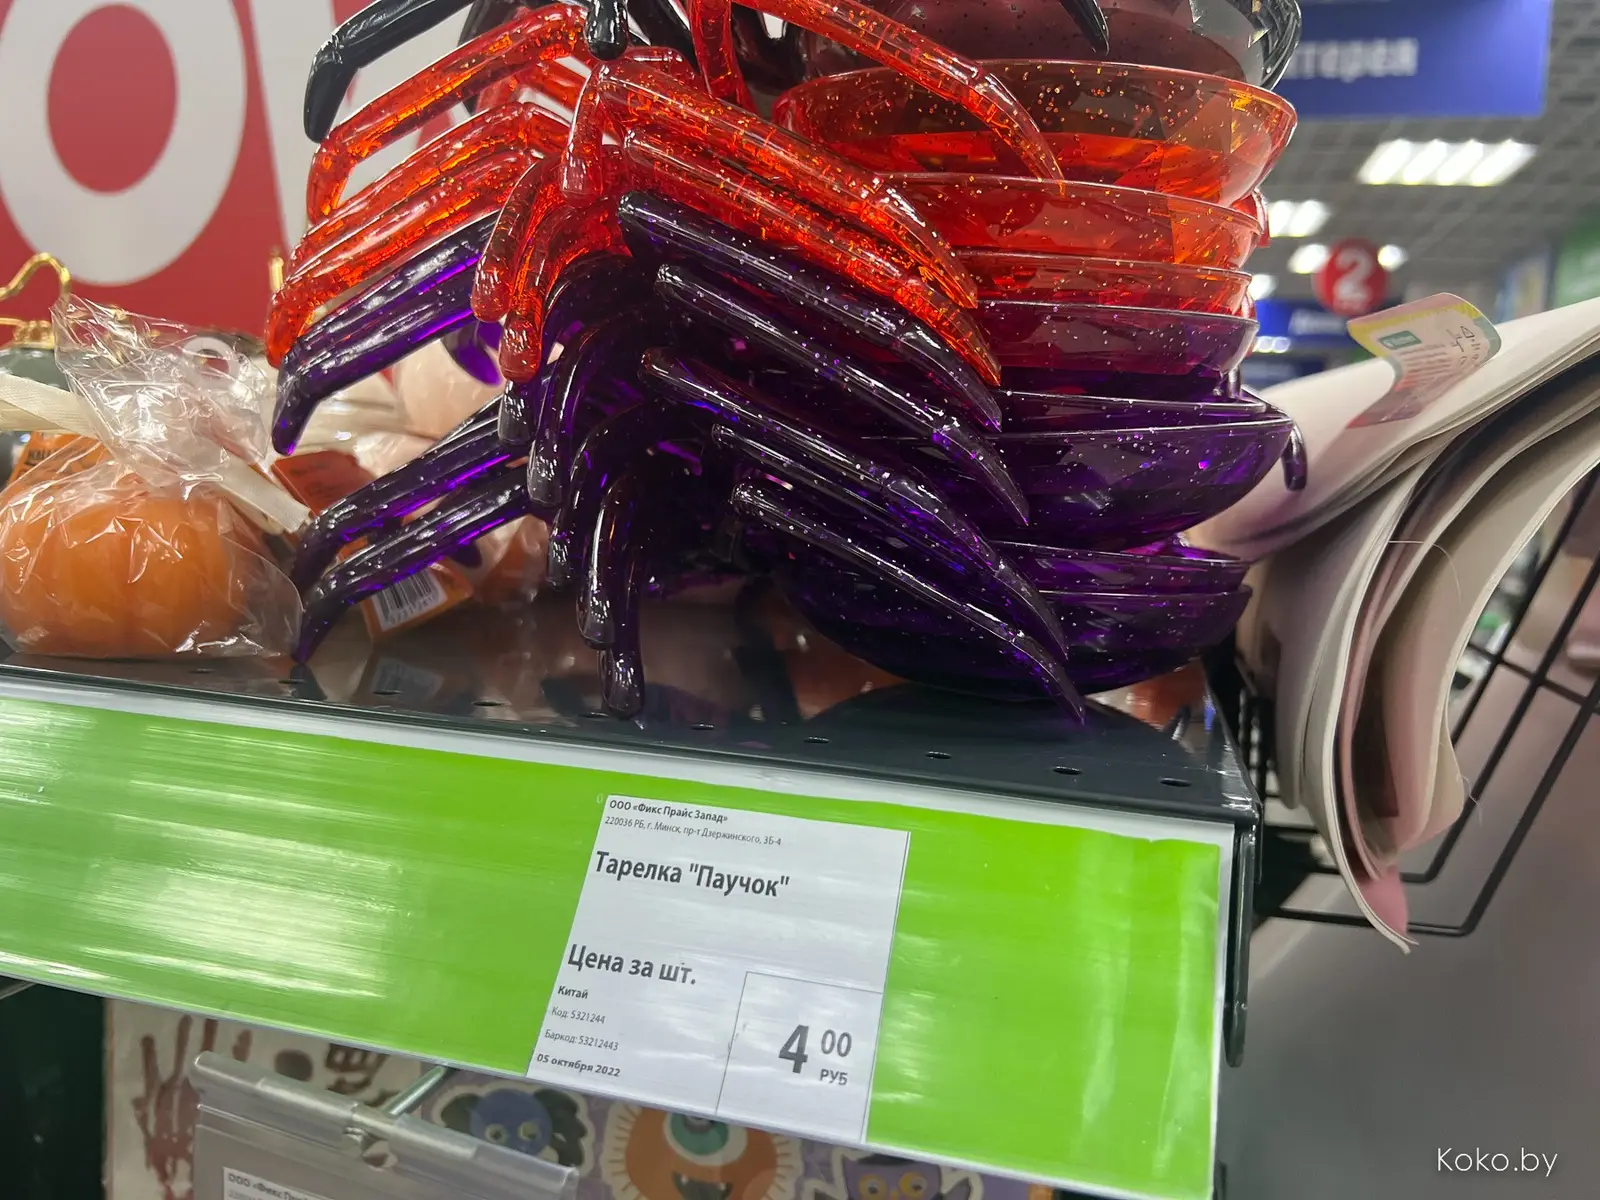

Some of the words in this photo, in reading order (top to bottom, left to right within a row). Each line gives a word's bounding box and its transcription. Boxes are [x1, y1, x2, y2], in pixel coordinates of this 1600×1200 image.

[1333, 248, 1374, 312] 2
[609, 799, 632, 811] ООО
[633, 803, 662, 815] «Фикс
[663, 805, 693, 818] Прайс
[694, 809, 729, 824] Запад»
[605, 816, 633, 828] 220036
[633, 819, 646, 830] РБ,
[646, 822, 653, 830] г.
[653, 821, 682, 834] Минск,
[683, 826, 701, 837] пр-т
[701, 827, 762, 845] Дзержинского,
[595, 850, 683, 883] Тарелка
[689, 862, 791, 897] "Паучок"
[567, 943, 625, 972] Цена
[628, 958, 655, 978] за
[658, 962, 697, 985] шт.
[557, 985, 589, 999] Китай
[551, 1006, 569, 1018] Код:
[570, 1009, 606, 1024] 5321244
[544, 1028, 578, 1044] Баркод:
[579, 1035, 619, 1051] 53212443
[778, 1024, 810, 1074] 4
[820, 1029, 853, 1058] 00
[536, 1053, 550, 1063] 05
[550, 1057, 594, 1072] октября
[595, 1064, 621, 1077] 2022
[819, 1068, 849, 1086] РУБ
